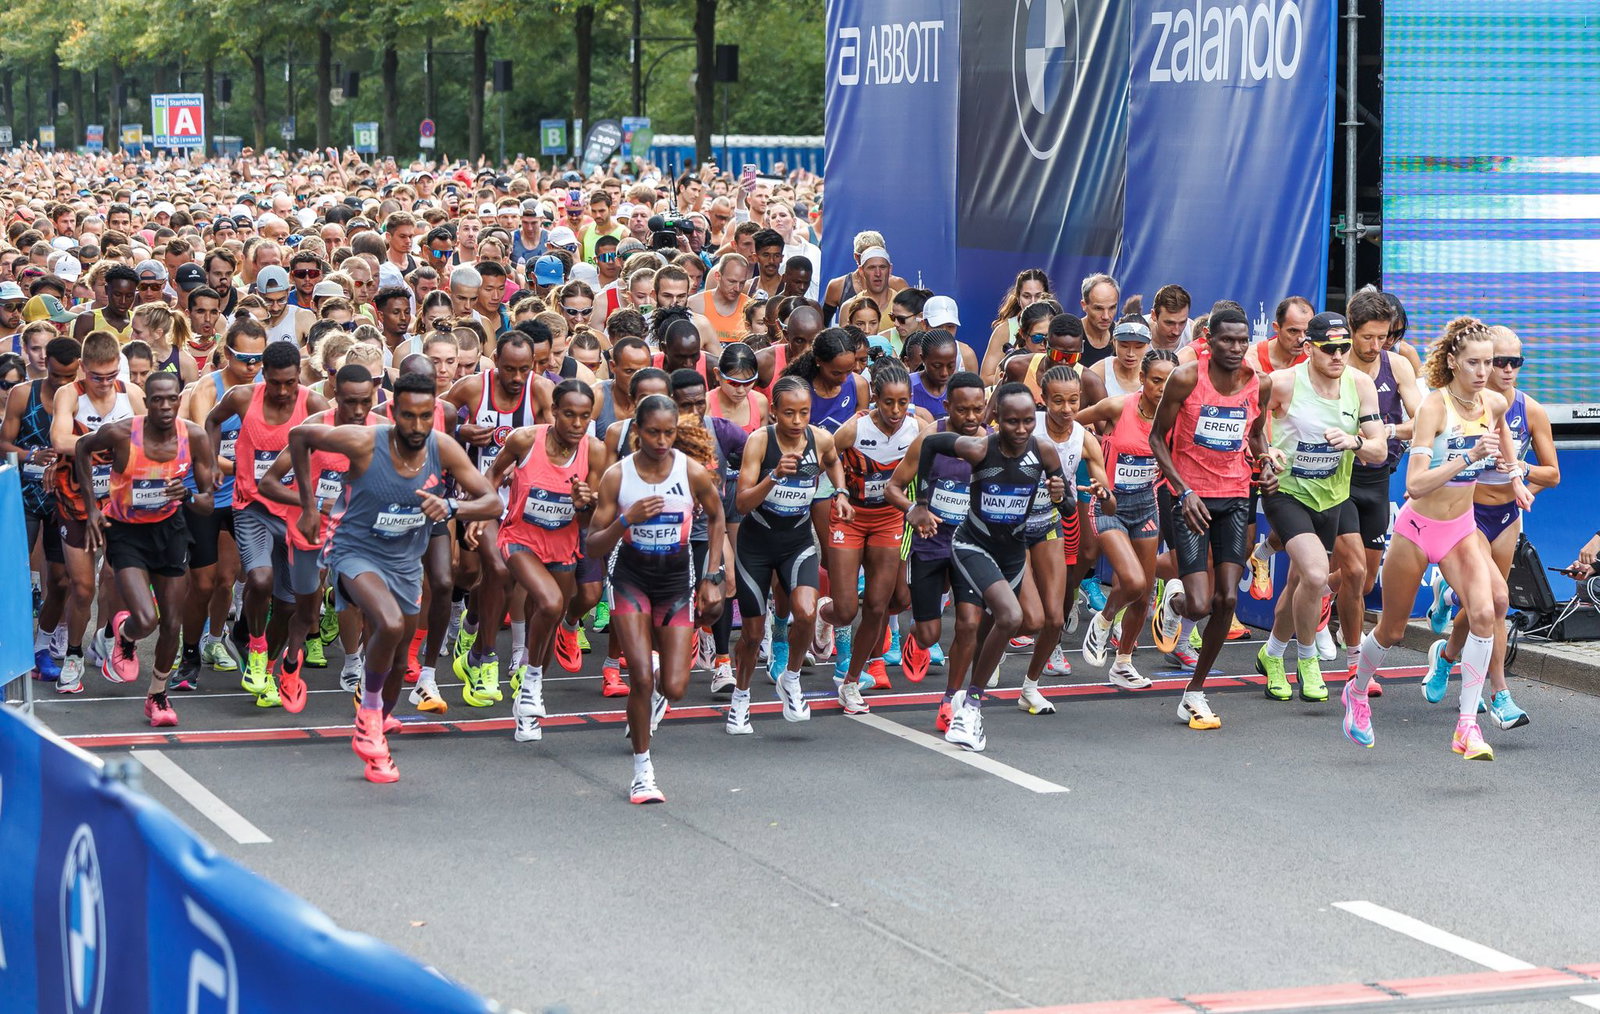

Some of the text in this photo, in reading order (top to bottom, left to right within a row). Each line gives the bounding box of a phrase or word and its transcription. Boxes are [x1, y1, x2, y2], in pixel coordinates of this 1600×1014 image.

[1150, 0, 1302, 83] zalando
[865, 20, 945, 85] ABBOTT
[169, 98, 200, 106] Startblock
[173, 107, 198, 135] A
[360, 130, 370, 146] B
[547, 128, 561, 147] B
[1204, 421, 1240, 433] ERENG
[1206, 438, 1232, 447] zalando
[1296, 454, 1340, 463] GRIFFITHS
[870, 483, 888, 491] AH
[774, 489, 808, 500] HIRPA
[531, 502, 572, 516] TARIKU
[380, 516, 424, 526] DUMECHA
[940, 510, 966, 521] zalando
[633, 527, 677, 539] ASSEFA
